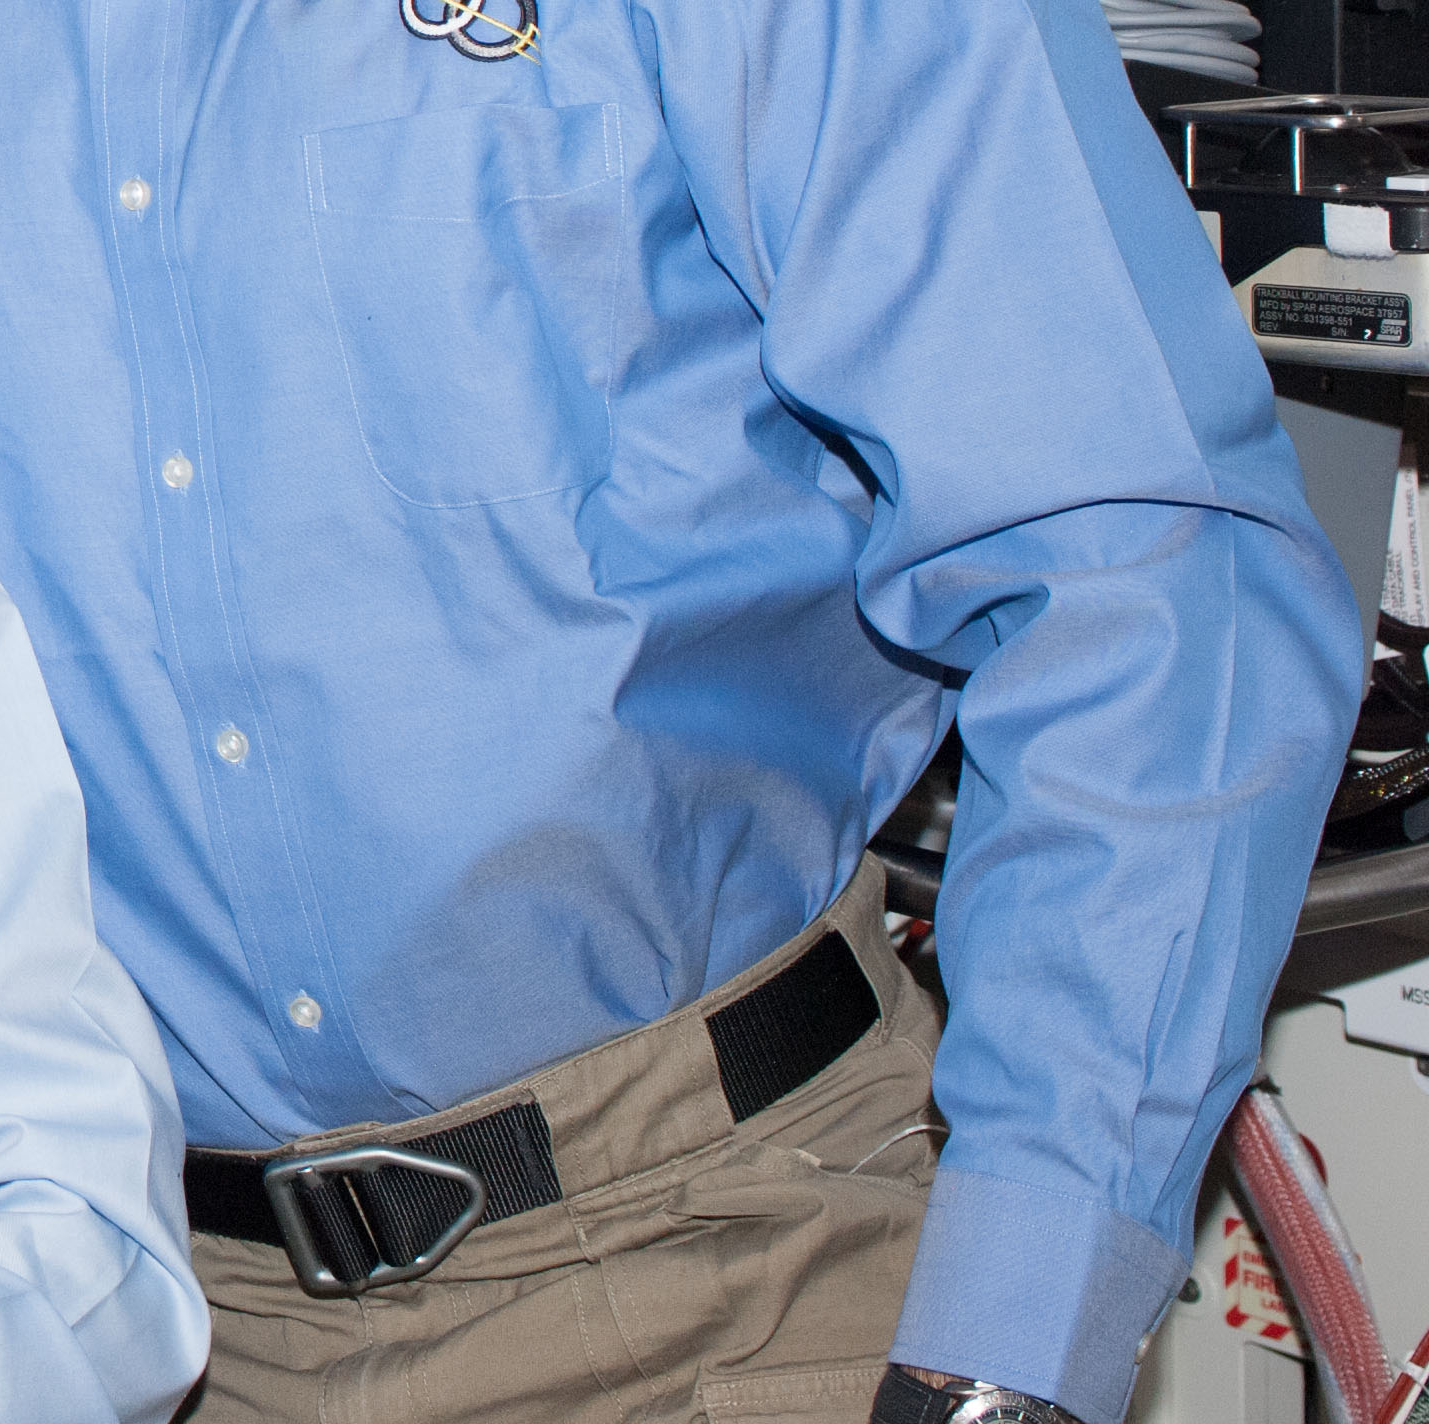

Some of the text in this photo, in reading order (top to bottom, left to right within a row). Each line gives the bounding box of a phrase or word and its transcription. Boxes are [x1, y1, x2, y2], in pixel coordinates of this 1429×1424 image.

[1258, 287, 1406, 308] TRACKBALL MOUNTING BRACKET ASSY
[1259, 299, 1279, 310] MFD
[1280, 301, 1291, 312] by
[1292, 302, 1318, 313] SPAR
[1318, 304, 1376, 317] AEROSPACE
[1259, 310, 1285, 322] ASSY
[1380, 325, 1403, 336] SPAR
